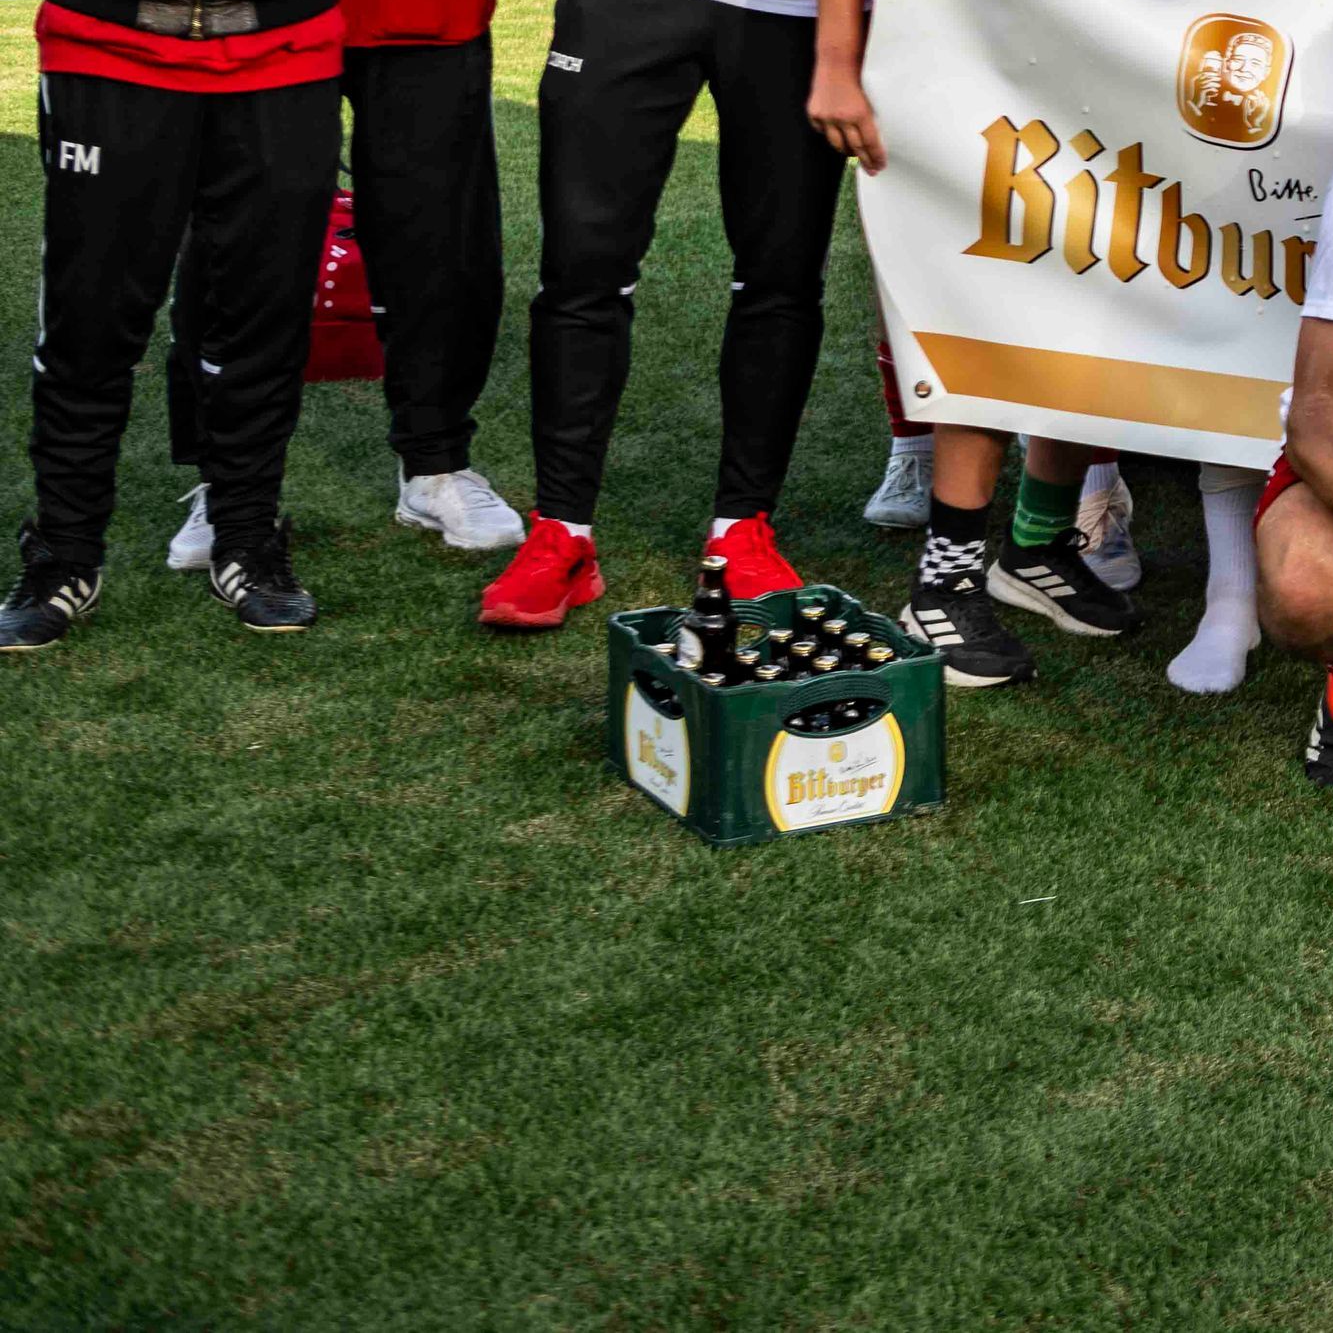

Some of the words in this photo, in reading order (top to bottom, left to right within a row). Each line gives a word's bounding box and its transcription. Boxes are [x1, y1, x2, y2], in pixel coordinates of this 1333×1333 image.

[60, 140, 101, 175] FM
[962, 114, 1318, 307] Bitbur
[785, 767, 887, 806] Bitburger
